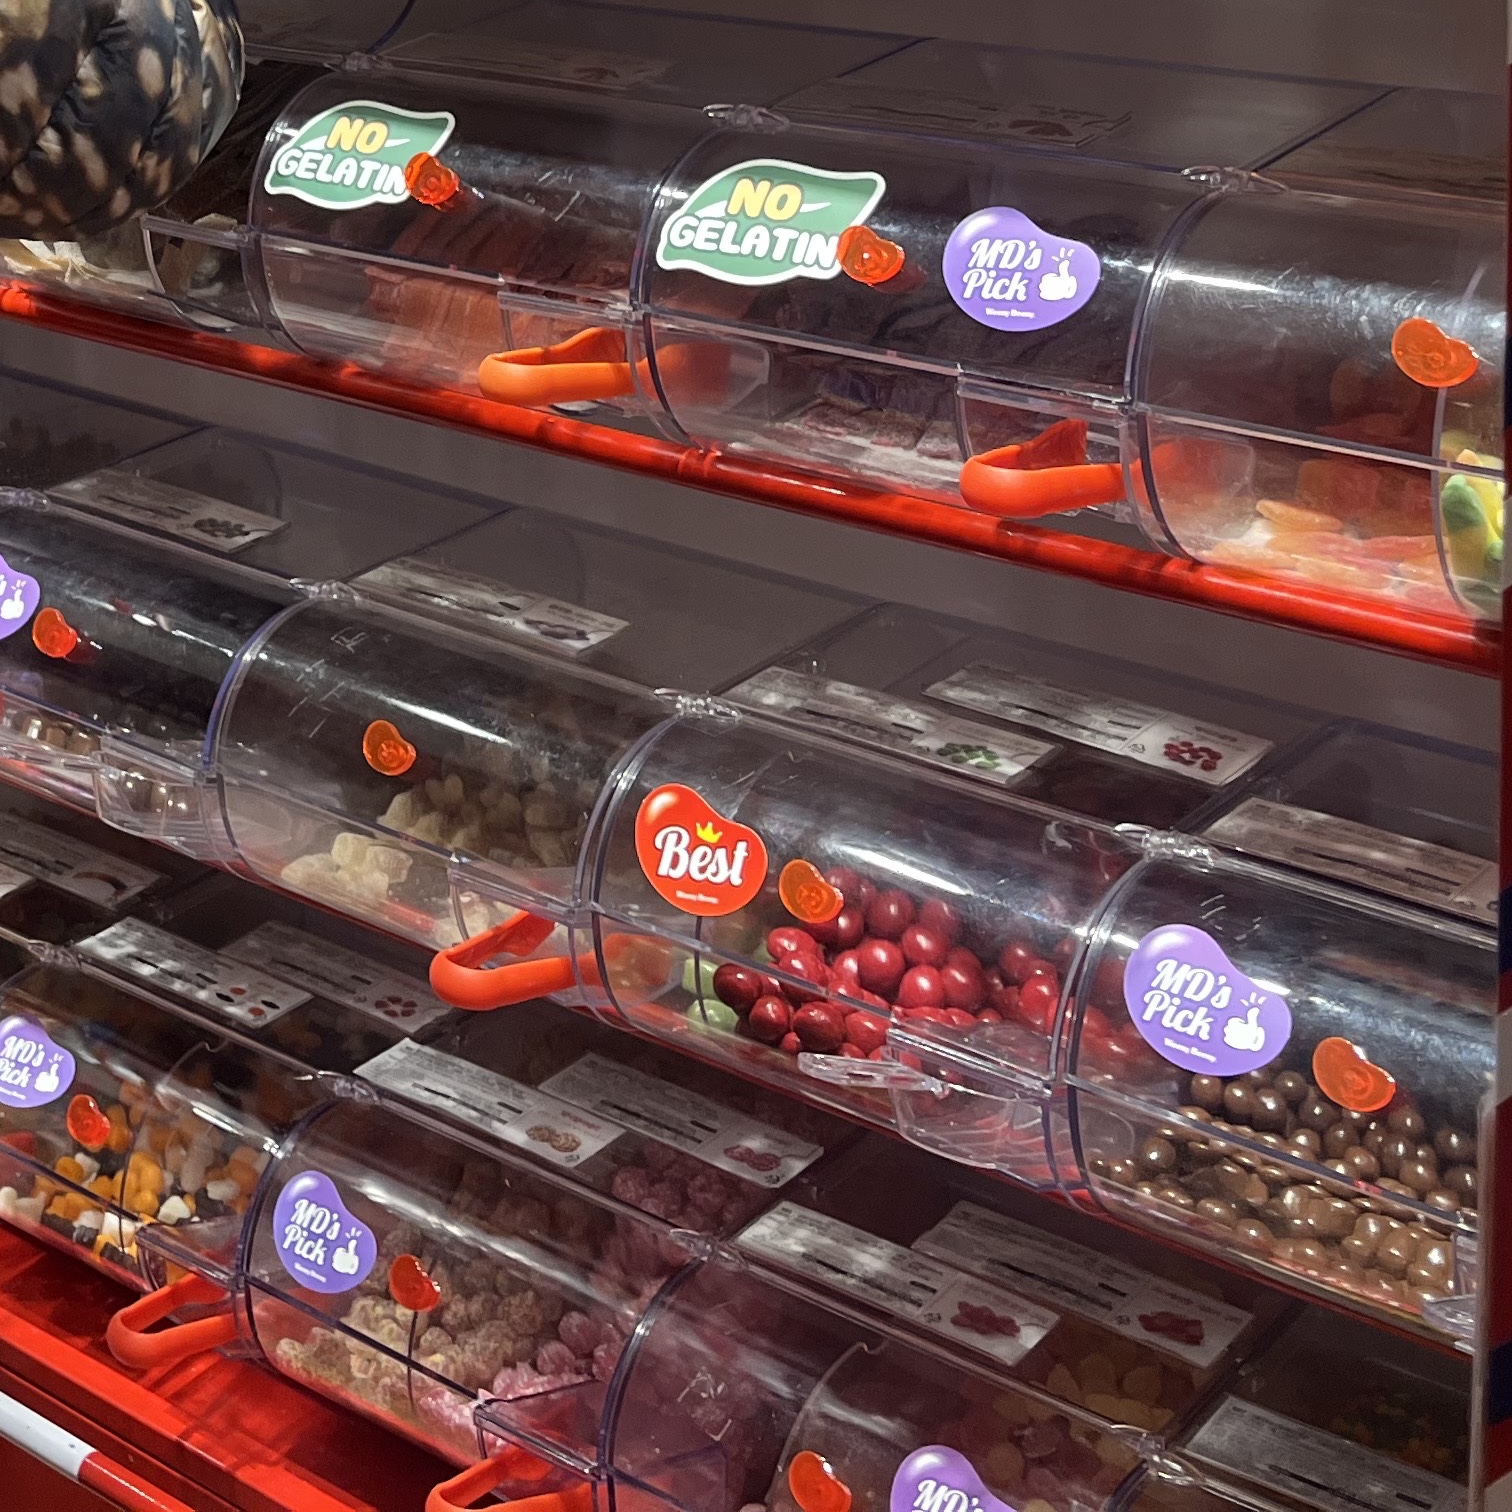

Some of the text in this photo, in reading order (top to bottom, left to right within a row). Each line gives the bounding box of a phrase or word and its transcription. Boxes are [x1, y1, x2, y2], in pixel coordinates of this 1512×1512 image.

[326, 116, 389, 154] NO
[277, 148, 406, 196] GELATIN
[725, 178, 803, 221] NO
[669, 215, 840, 270] GELATIN
[967, 238, 1043, 271] MD's
[962, 271, 1028, 301] Pick
[654, 825, 749, 887] Best
[1150, 958, 1233, 1009] MD's
[1142, 990, 1215, 1040] Pick
[0, 1035, 46, 1067] MD's
[290, 1198, 341, 1240] MD's
[282, 1223, 328, 1266] Pick
[913, 1479, 984, 1512] MD'
